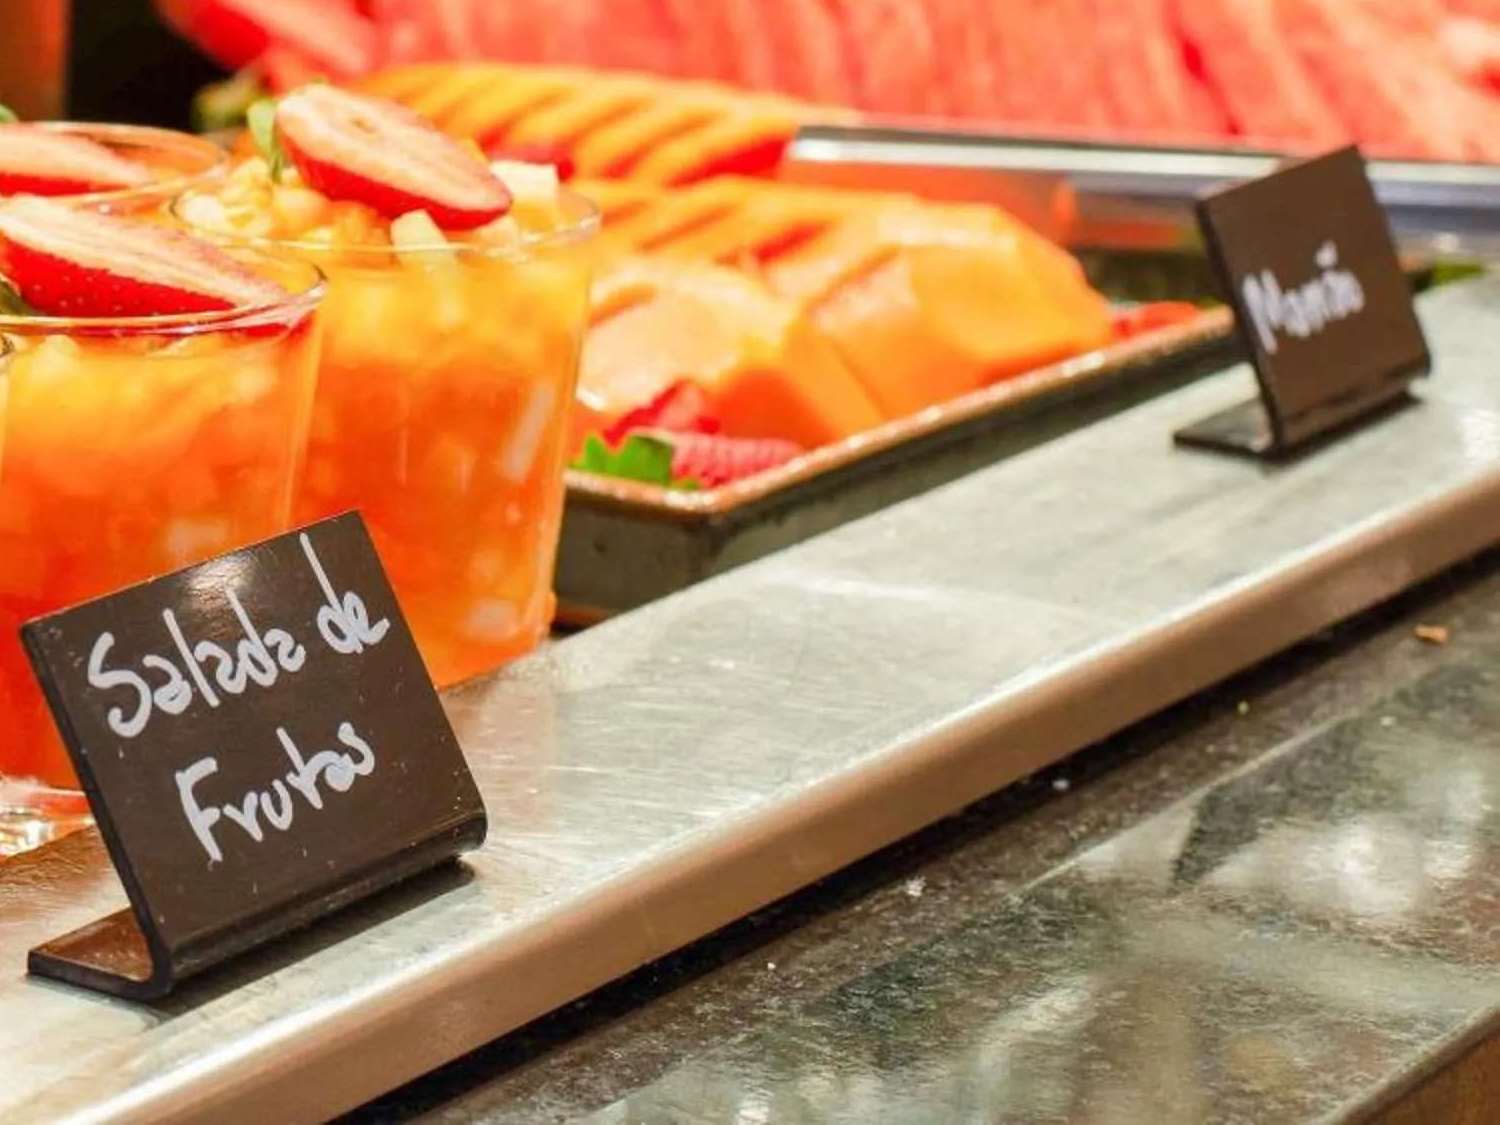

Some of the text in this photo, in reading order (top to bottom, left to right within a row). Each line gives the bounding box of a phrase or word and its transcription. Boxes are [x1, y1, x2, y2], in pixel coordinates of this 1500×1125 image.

[88, 533, 390, 738] Salada de
[175, 722, 375, 862] Frutas
